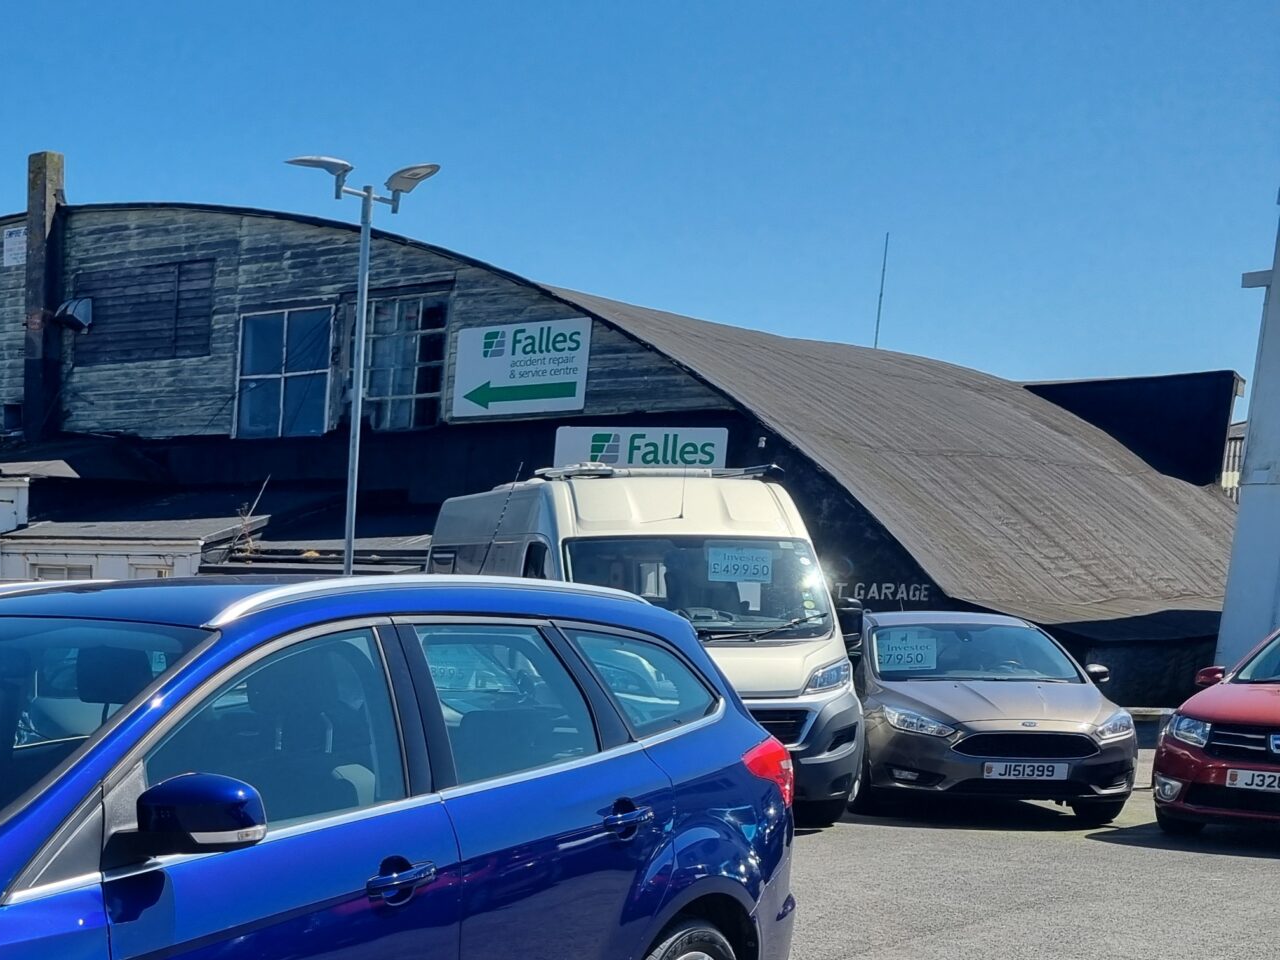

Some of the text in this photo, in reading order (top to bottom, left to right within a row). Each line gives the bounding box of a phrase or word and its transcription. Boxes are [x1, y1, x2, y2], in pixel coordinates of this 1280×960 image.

[511, 326, 581, 356] Falles
[510, 354, 576, 367] accident repair
[509, 366, 578, 379] & service centre
[627, 433, 715, 466] Falles
[723, 552, 768, 562] Investec
[712, 562, 770, 576] £49950
[853, 582, 930, 601] GARAGE
[887, 644, 931, 652] Investec
[878, 653, 923, 665] £7950
[998, 764, 1055, 778] J151399
[1244, 773, 1280, 789] J32
